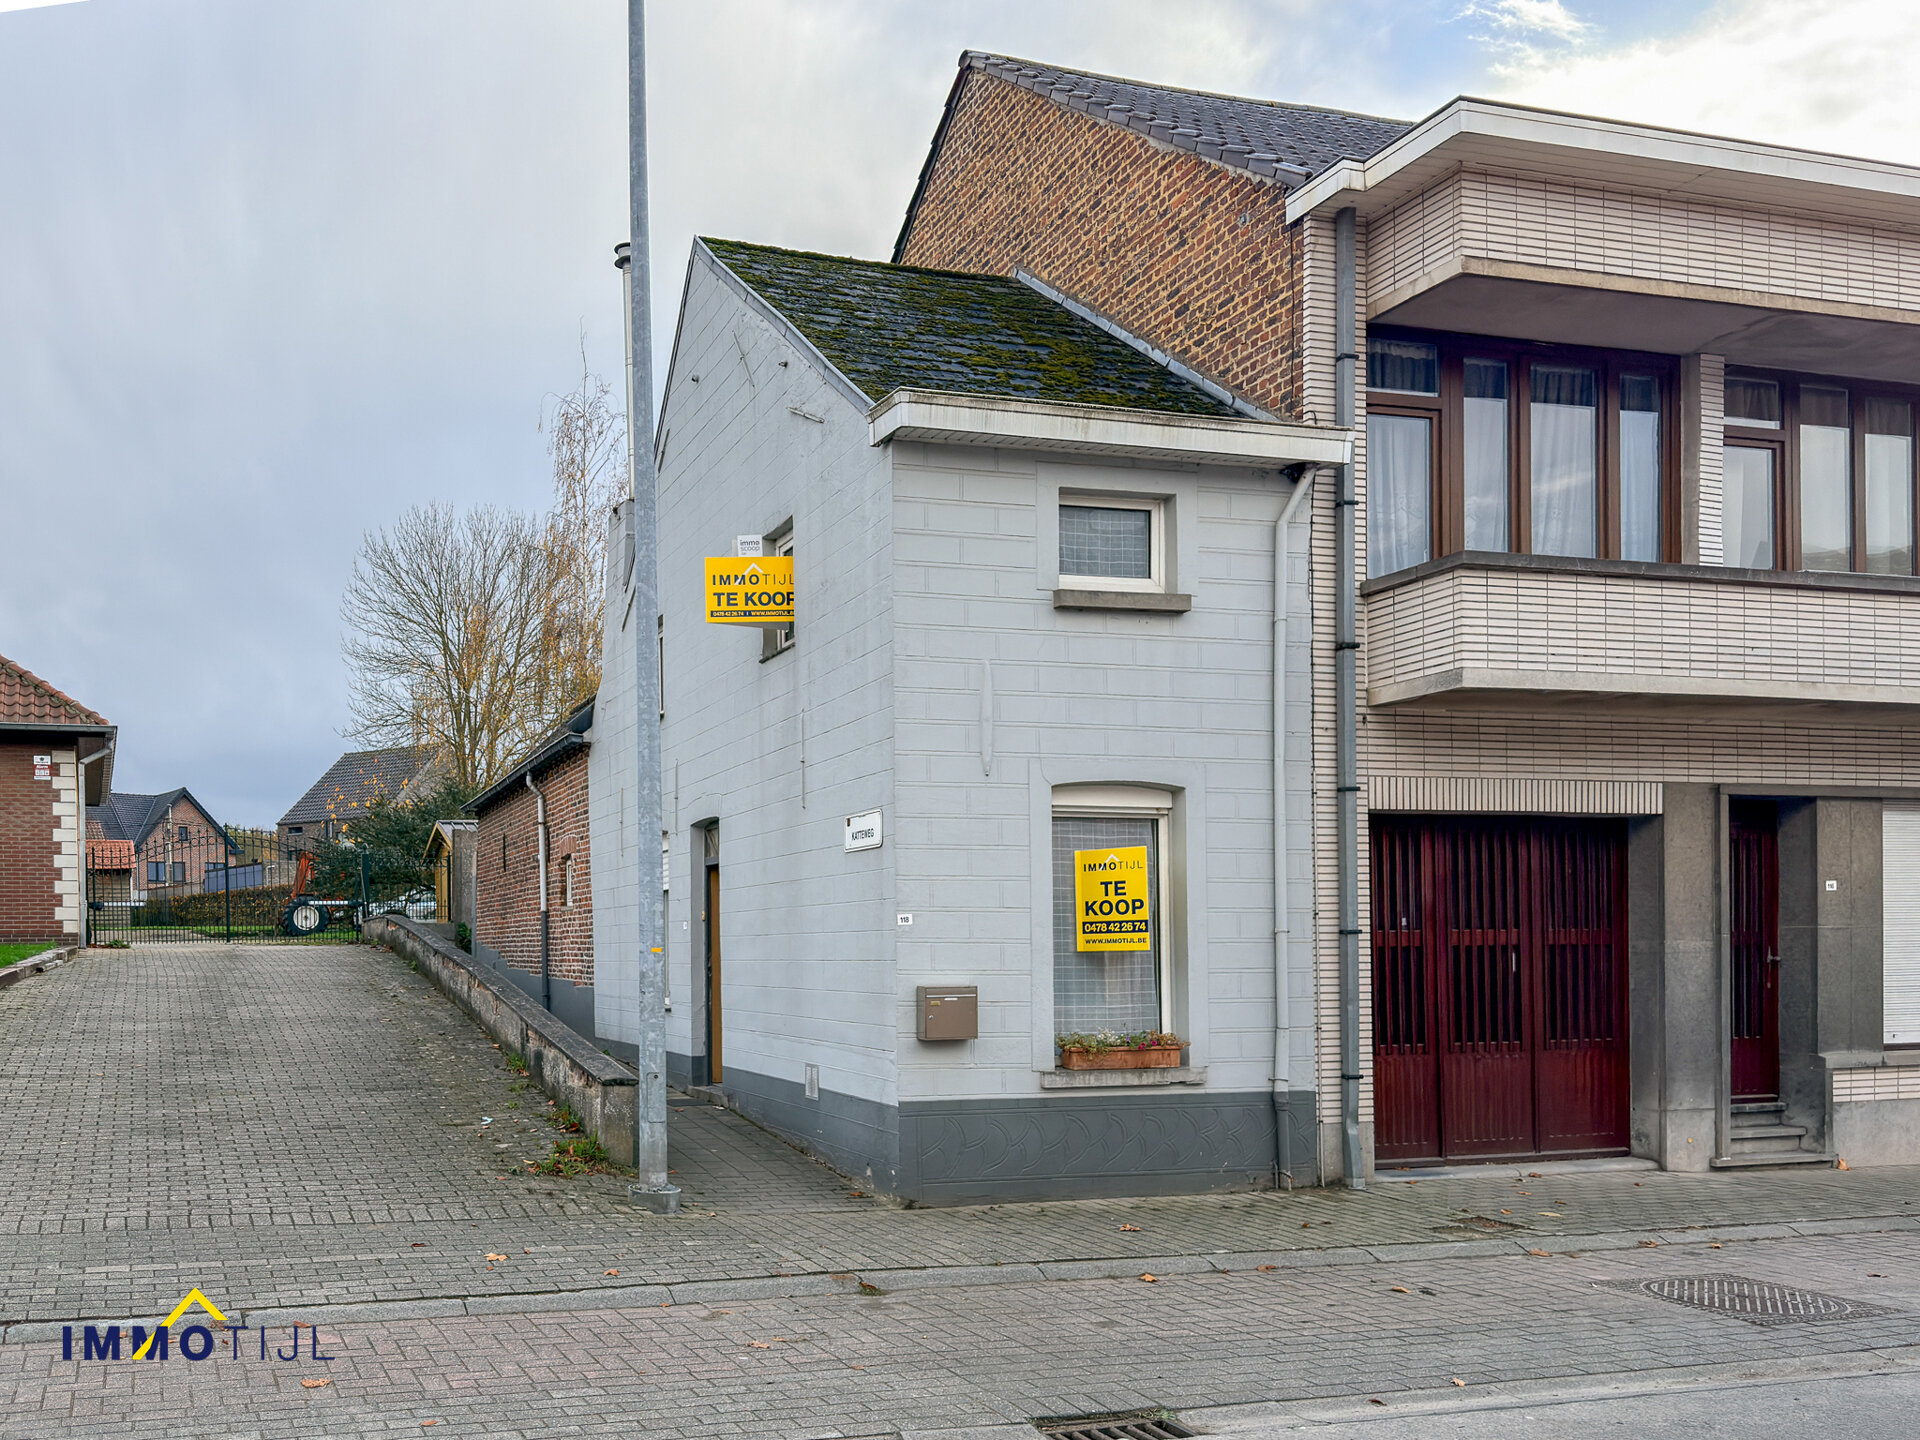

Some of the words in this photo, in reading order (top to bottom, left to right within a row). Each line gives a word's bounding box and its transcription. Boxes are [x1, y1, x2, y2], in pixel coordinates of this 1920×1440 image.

[712, 573, 794, 586] IMMOTIJL
[713, 592, 738, 607] TE
[744, 591, 794, 606] KOOP
[852, 828, 874, 840] KATTEWEG
[1083, 861, 1143, 872] IMMOTIJL
[1100, 880, 1126, 896] TE
[1084, 899, 1144, 916] KOOP
[1084, 923, 1108, 932] 0478
[1108, 922, 1120, 932] 42
[1121, 922, 1134, 932] 26
[1134, 922, 1146, 931] 74
